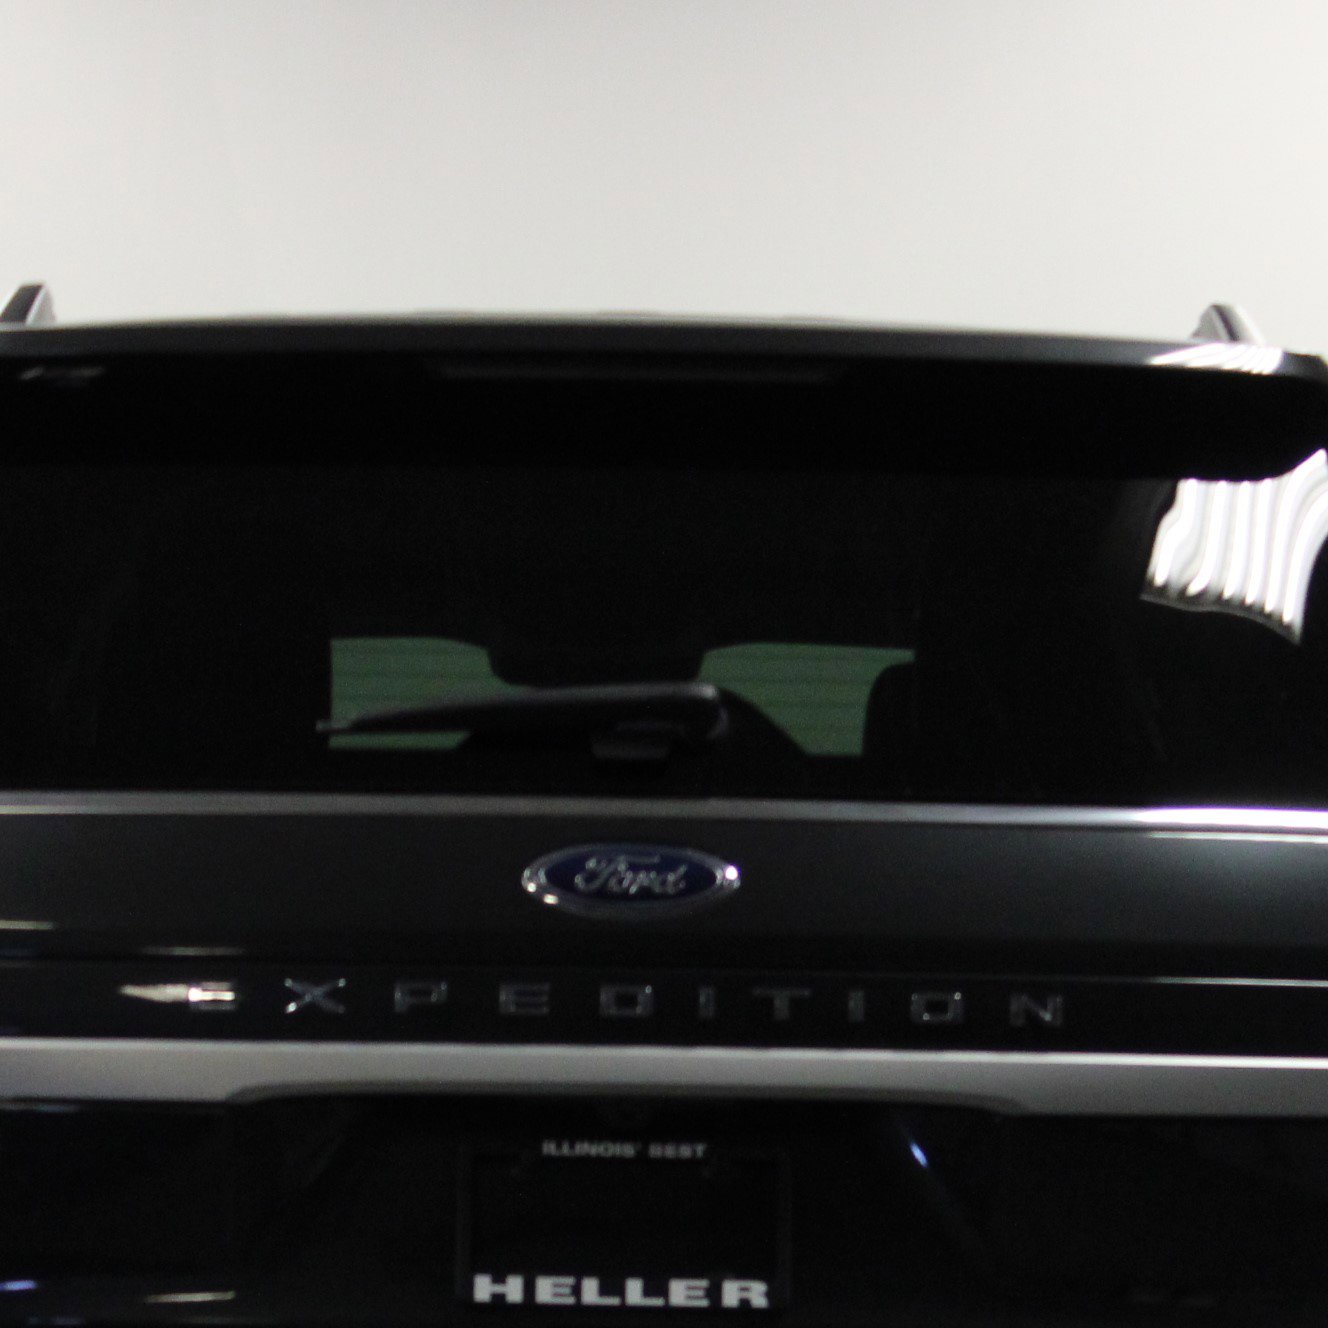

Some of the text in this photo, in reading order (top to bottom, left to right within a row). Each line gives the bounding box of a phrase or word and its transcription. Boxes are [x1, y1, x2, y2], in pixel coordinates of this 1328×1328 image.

[574, 853, 688, 895] Ford
[188, 980, 1063, 1028] EXPEDITION
[473, 1272, 770, 1309] HELLER
